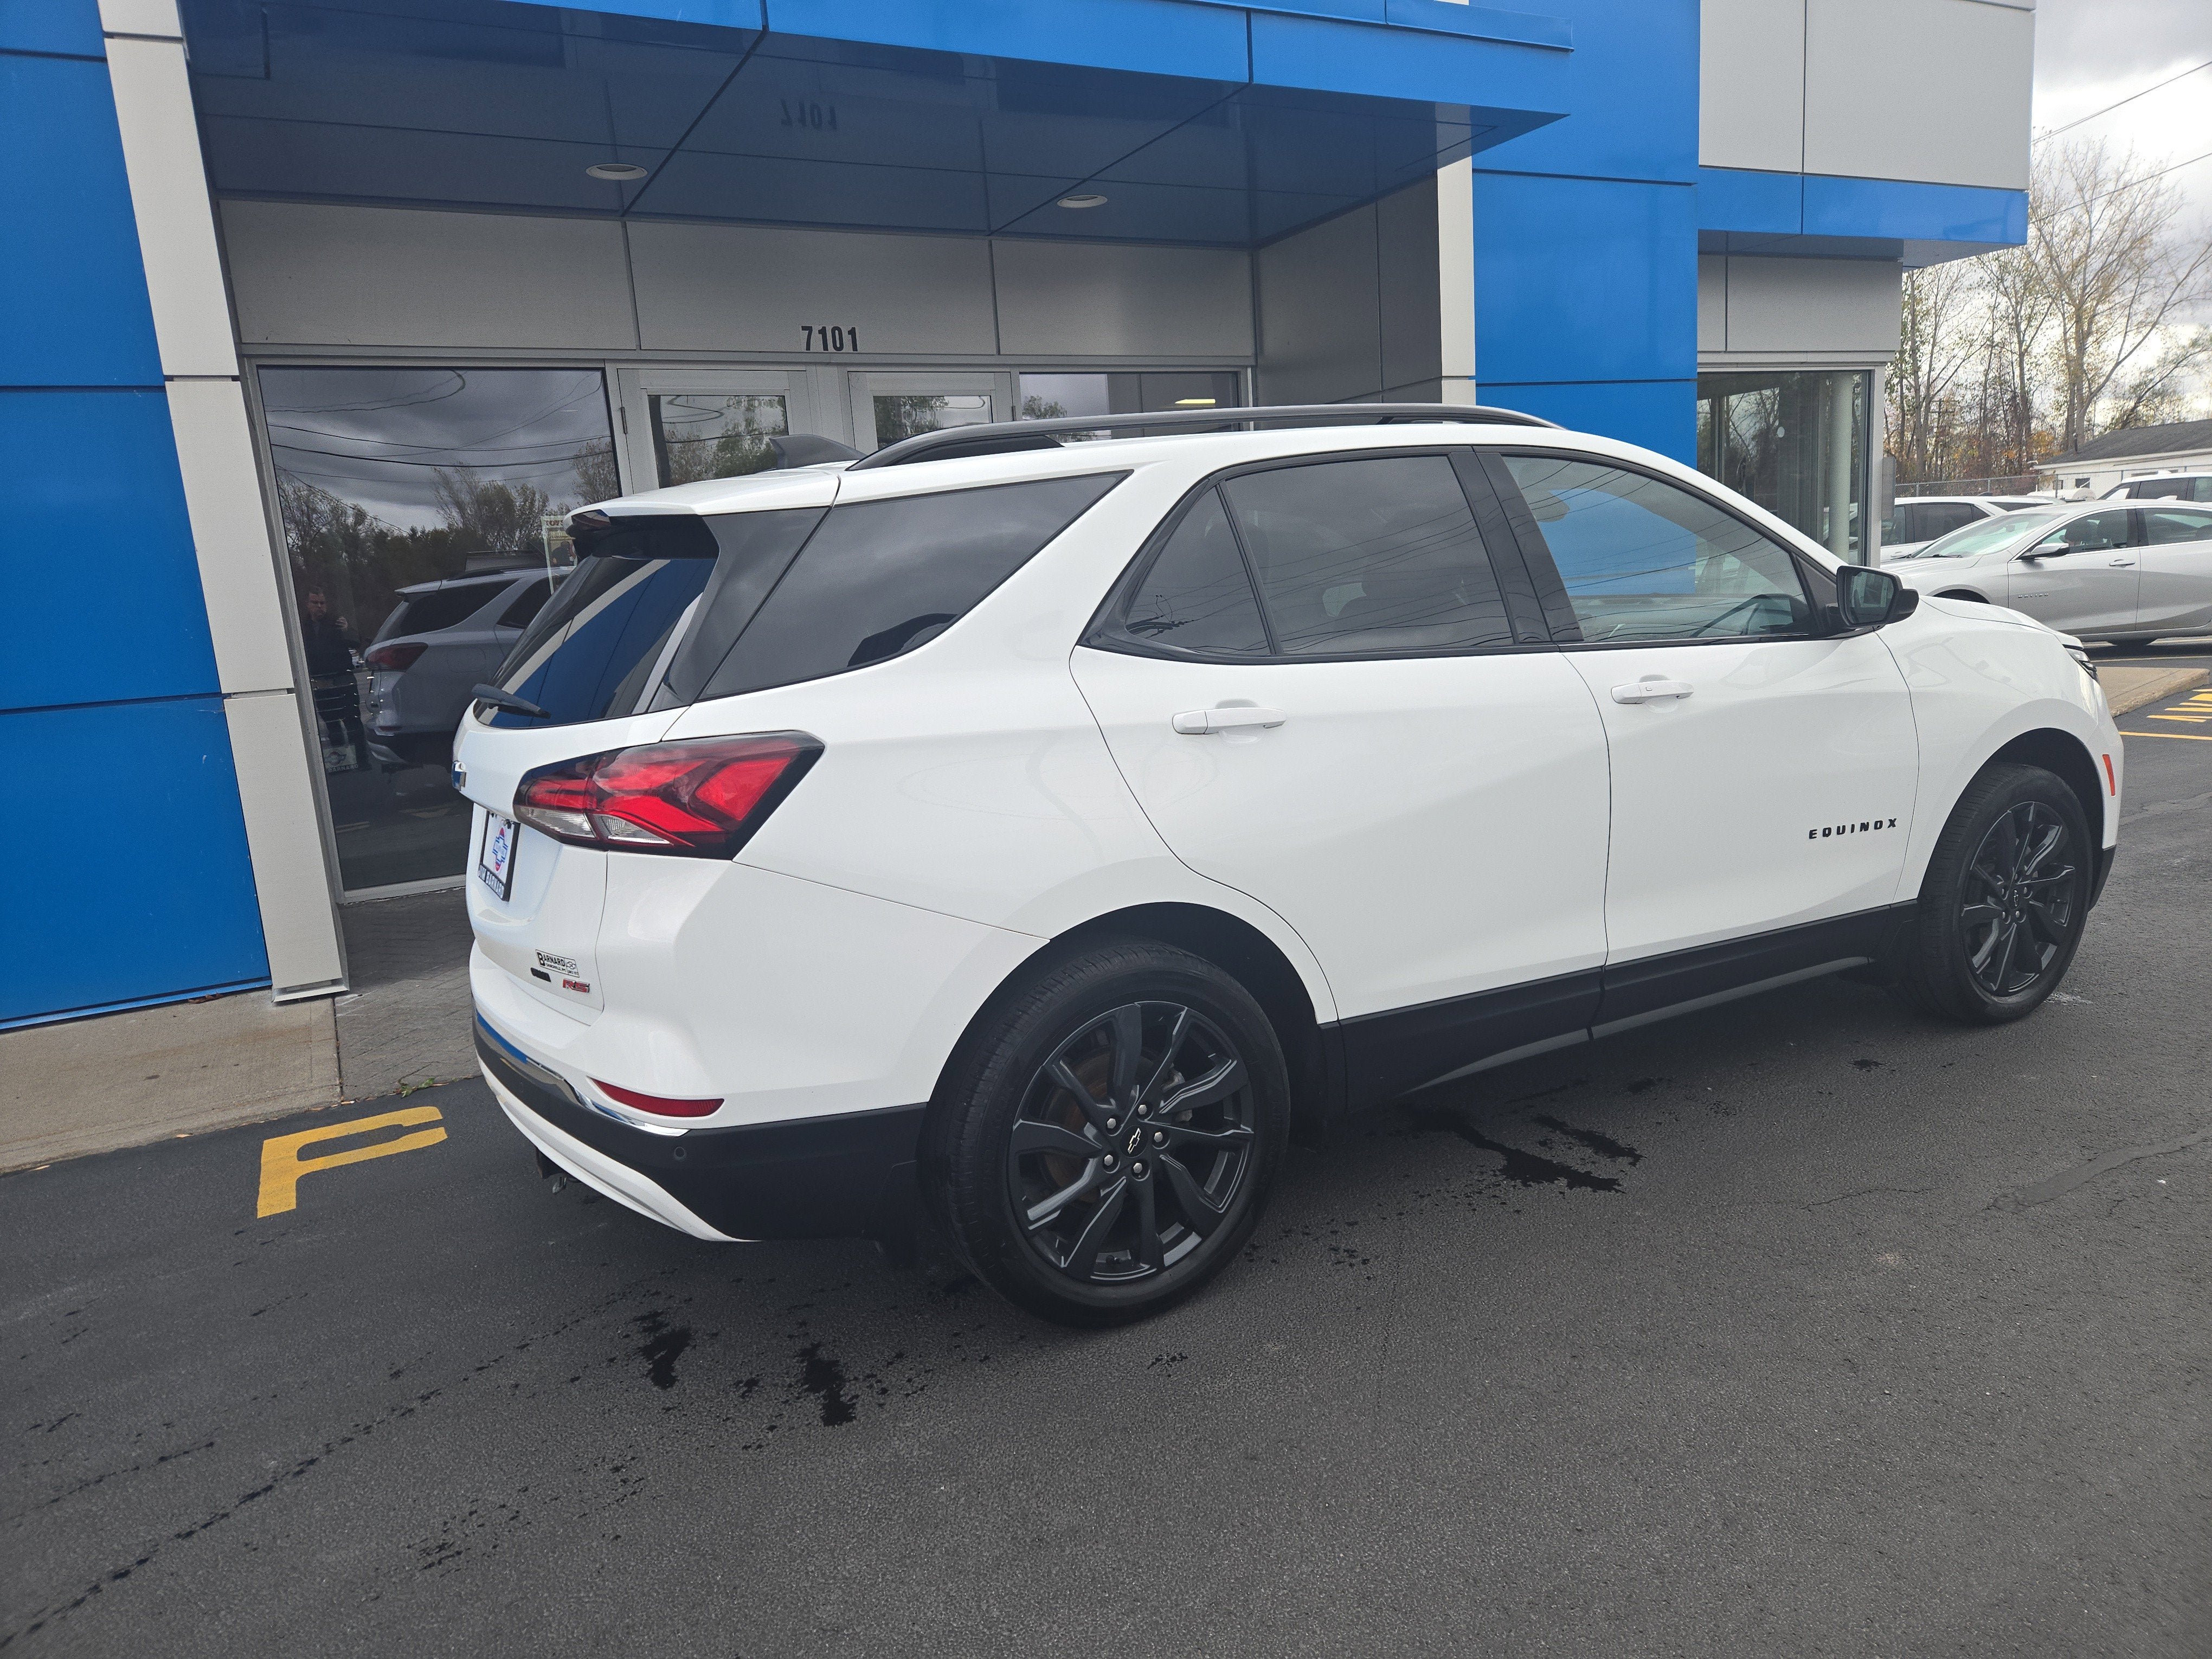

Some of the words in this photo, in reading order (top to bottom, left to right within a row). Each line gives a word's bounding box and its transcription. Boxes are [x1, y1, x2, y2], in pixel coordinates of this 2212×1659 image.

[801, 325, 858, 352] 7101
[1809, 818, 1897, 839] EQUINOX
[537, 951, 565, 967] BARNARD
[563, 978, 590, 993] RS
